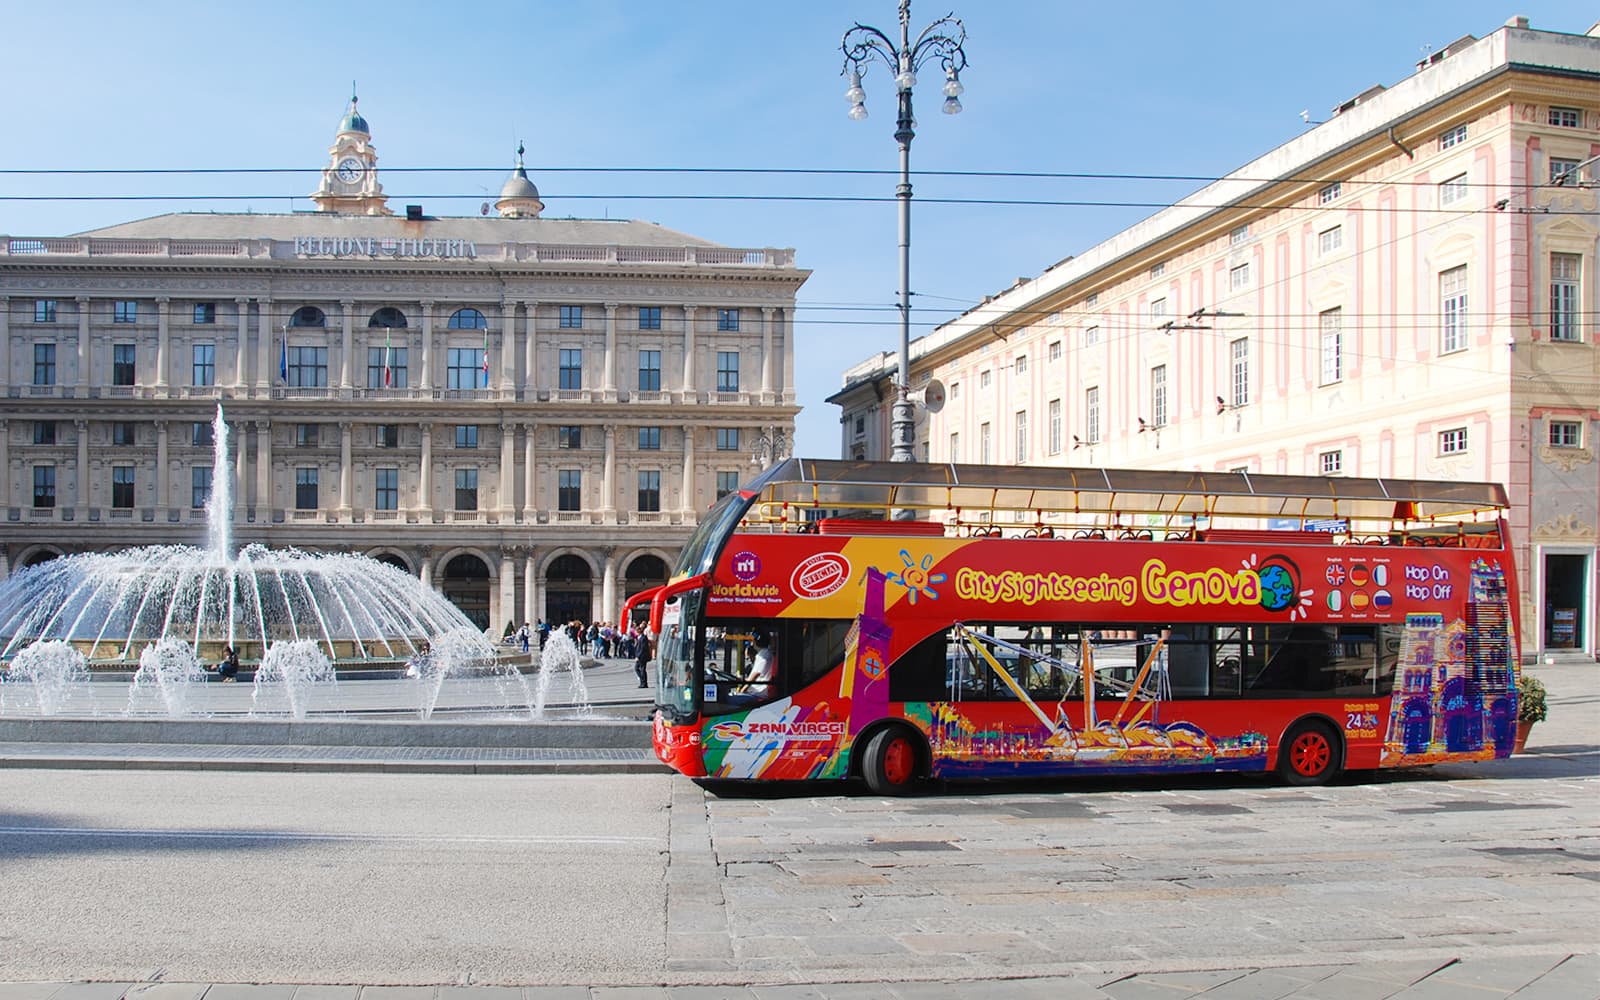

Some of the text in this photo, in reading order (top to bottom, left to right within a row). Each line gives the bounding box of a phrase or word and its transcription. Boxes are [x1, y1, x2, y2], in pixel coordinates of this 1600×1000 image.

[293, 236, 478, 257] REGIONE LIGURIA
[802, 565, 839, 585] OFFICIAL
[1405, 565, 1448, 581] Hop On
[713, 584, 779, 596] Worldwide
[1141, 559, 1262, 606] Genova
[1406, 584, 1452, 600] Hop Off
[749, 723, 845, 734] ZANI VIAGGI
[1346, 713, 1361, 729] 24
